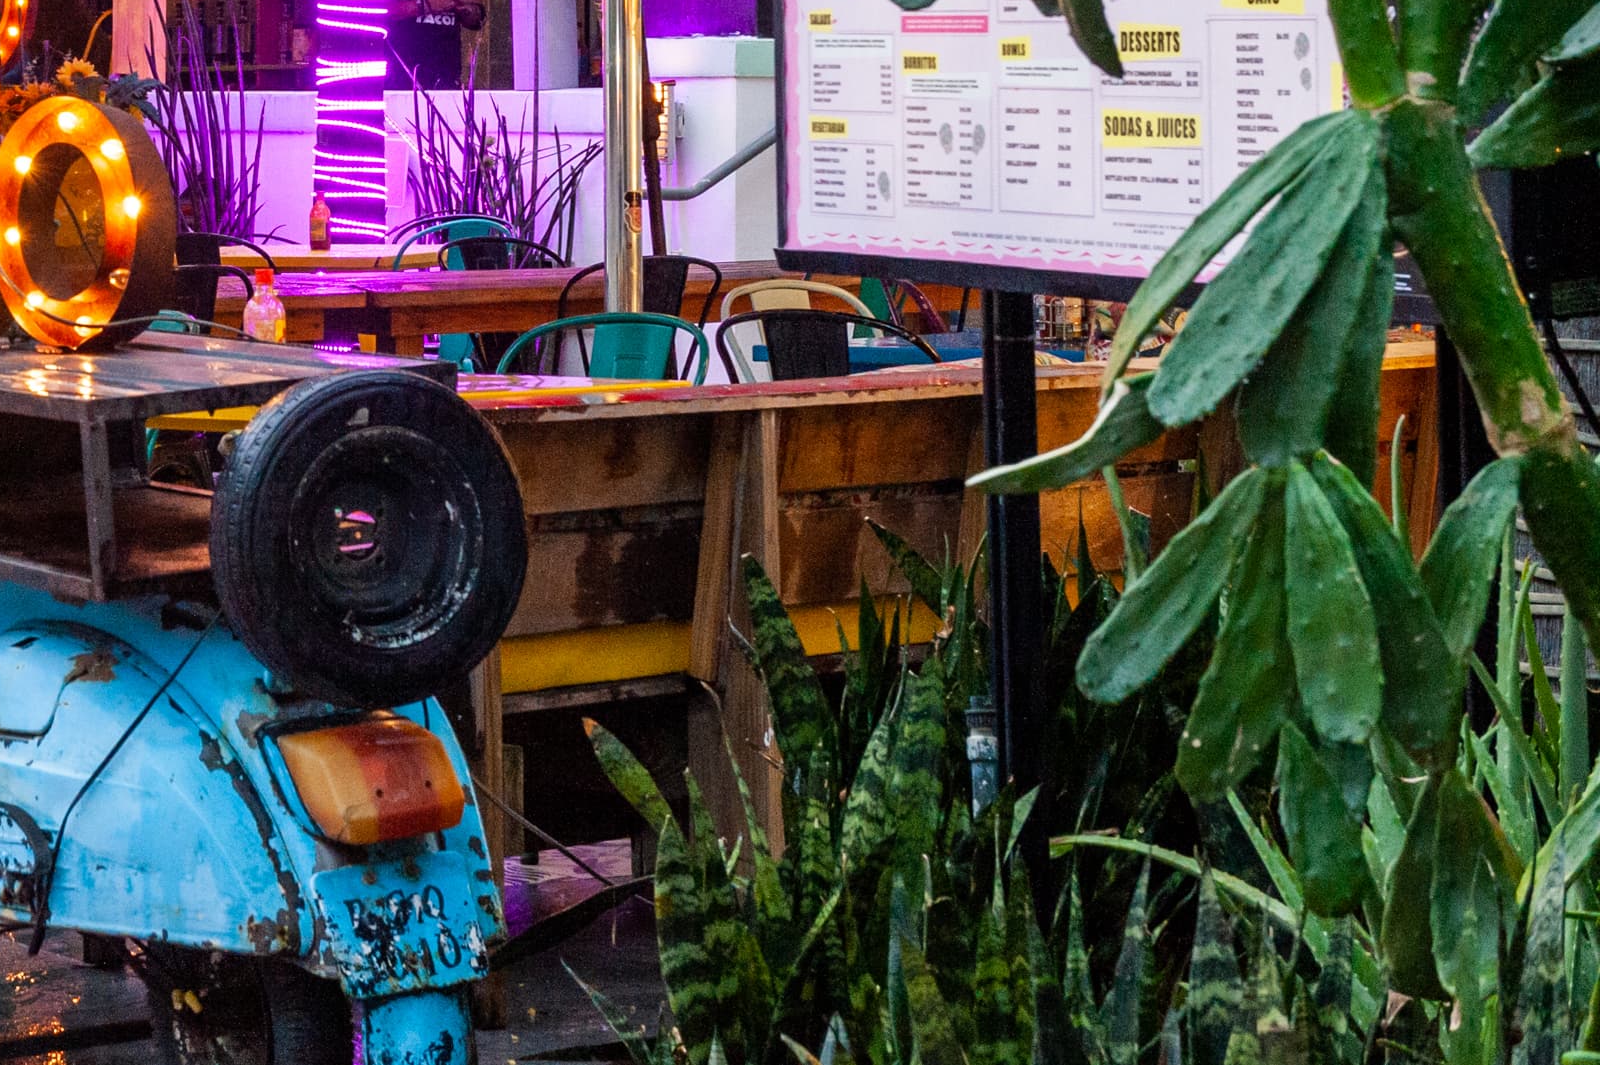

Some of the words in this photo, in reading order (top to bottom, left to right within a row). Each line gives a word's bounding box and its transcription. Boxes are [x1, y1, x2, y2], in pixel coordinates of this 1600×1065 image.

[1002, 43, 1026, 56] BOWLS
[1120, 31, 1180, 53] DESSERTS
[904, 56, 936, 69] BURRITOS
[1104, 116, 1142, 136] SODAS
[1146, 120, 1153, 137] &
[1157, 118, 1196, 139] JUICES
